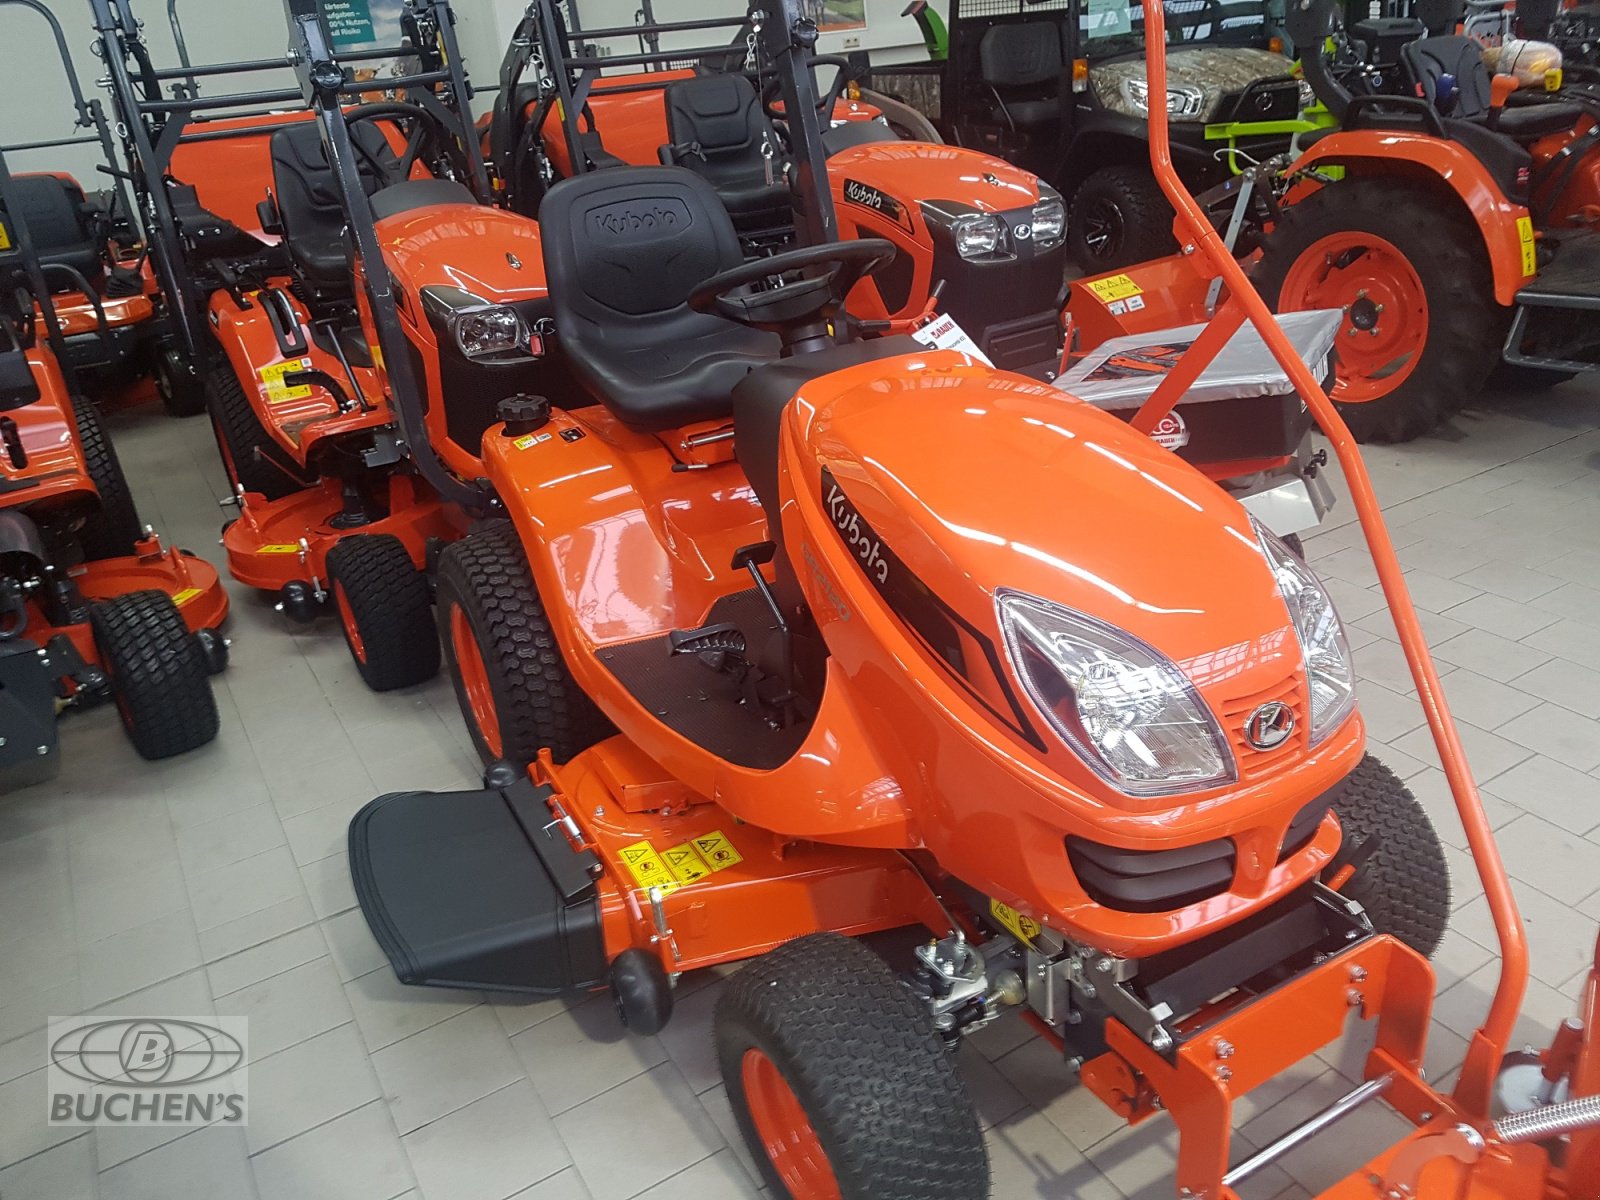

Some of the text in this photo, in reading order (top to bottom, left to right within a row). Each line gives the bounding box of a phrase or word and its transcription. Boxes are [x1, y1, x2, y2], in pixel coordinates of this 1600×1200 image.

[327, 11, 355, 20] ufgaben
[329, 20, 345, 28] 00%
[847, 181, 882, 209] Kubota
[595, 207, 677, 234] Kubota
[827, 484, 889, 584] Kubota
